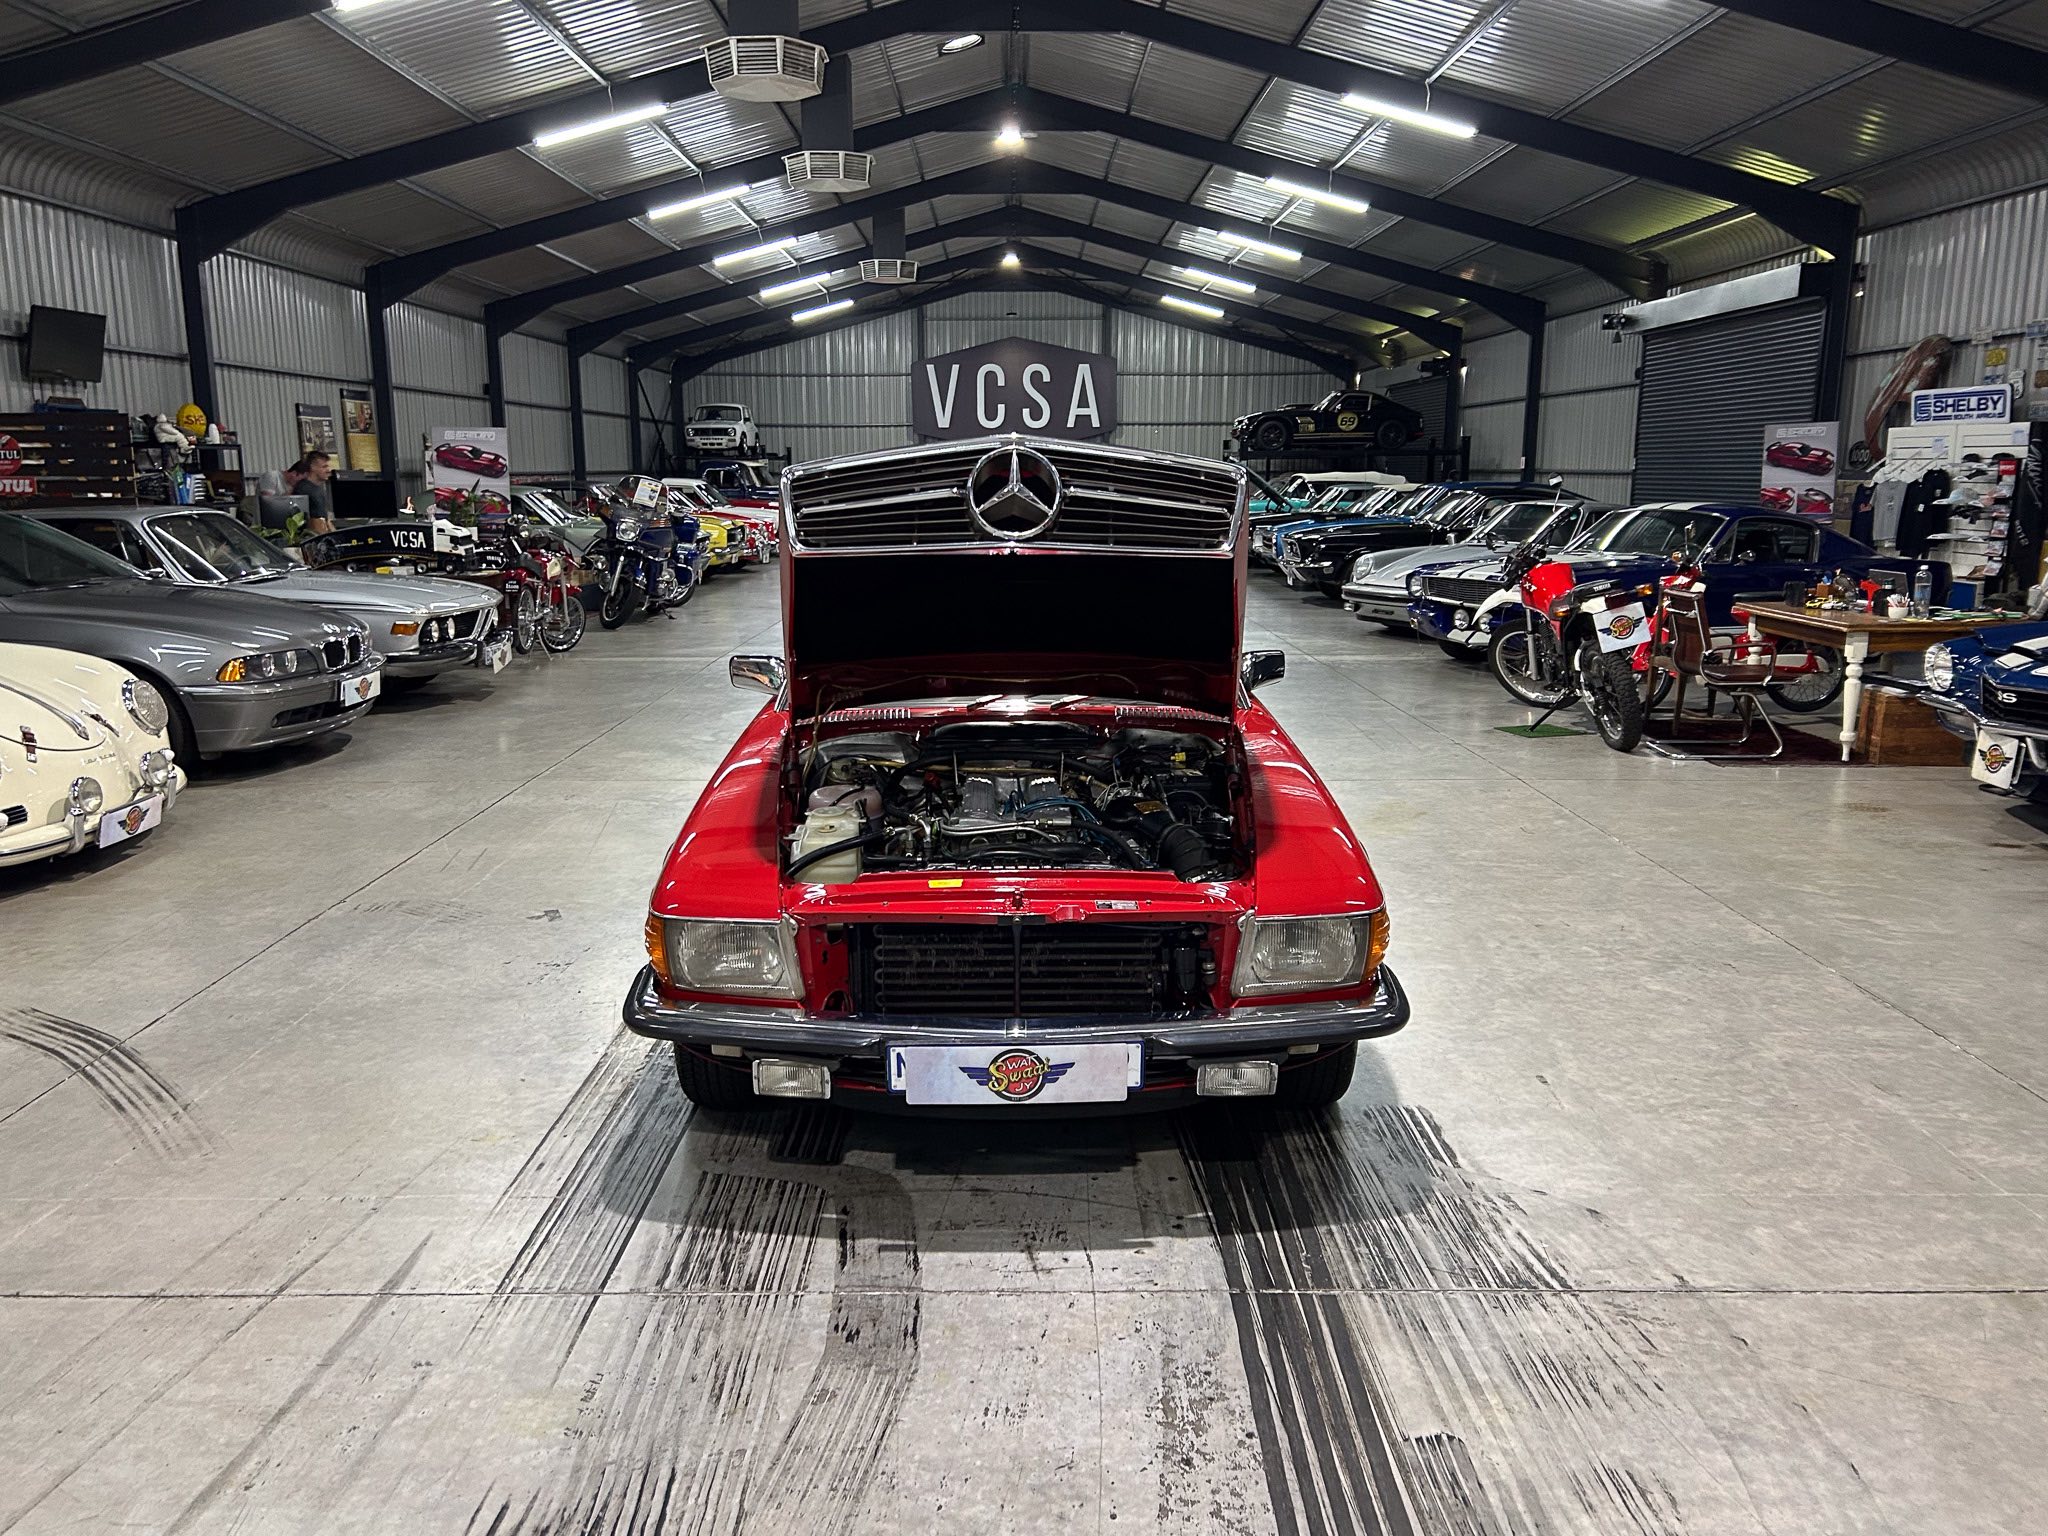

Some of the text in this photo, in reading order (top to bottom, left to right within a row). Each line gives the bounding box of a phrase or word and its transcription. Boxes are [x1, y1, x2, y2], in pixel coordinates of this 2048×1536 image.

[926, 363, 1100, 429] VCSA
[1933, 396, 2003, 414] SHELBY
[1340, 416, 1356, 426] 69
[390, 530, 427, 549] VCSA
[1523, 581, 1537, 592] XT
[1006, 1054, 1038, 1070] WAT
[1015, 1081, 1033, 1092] JY
